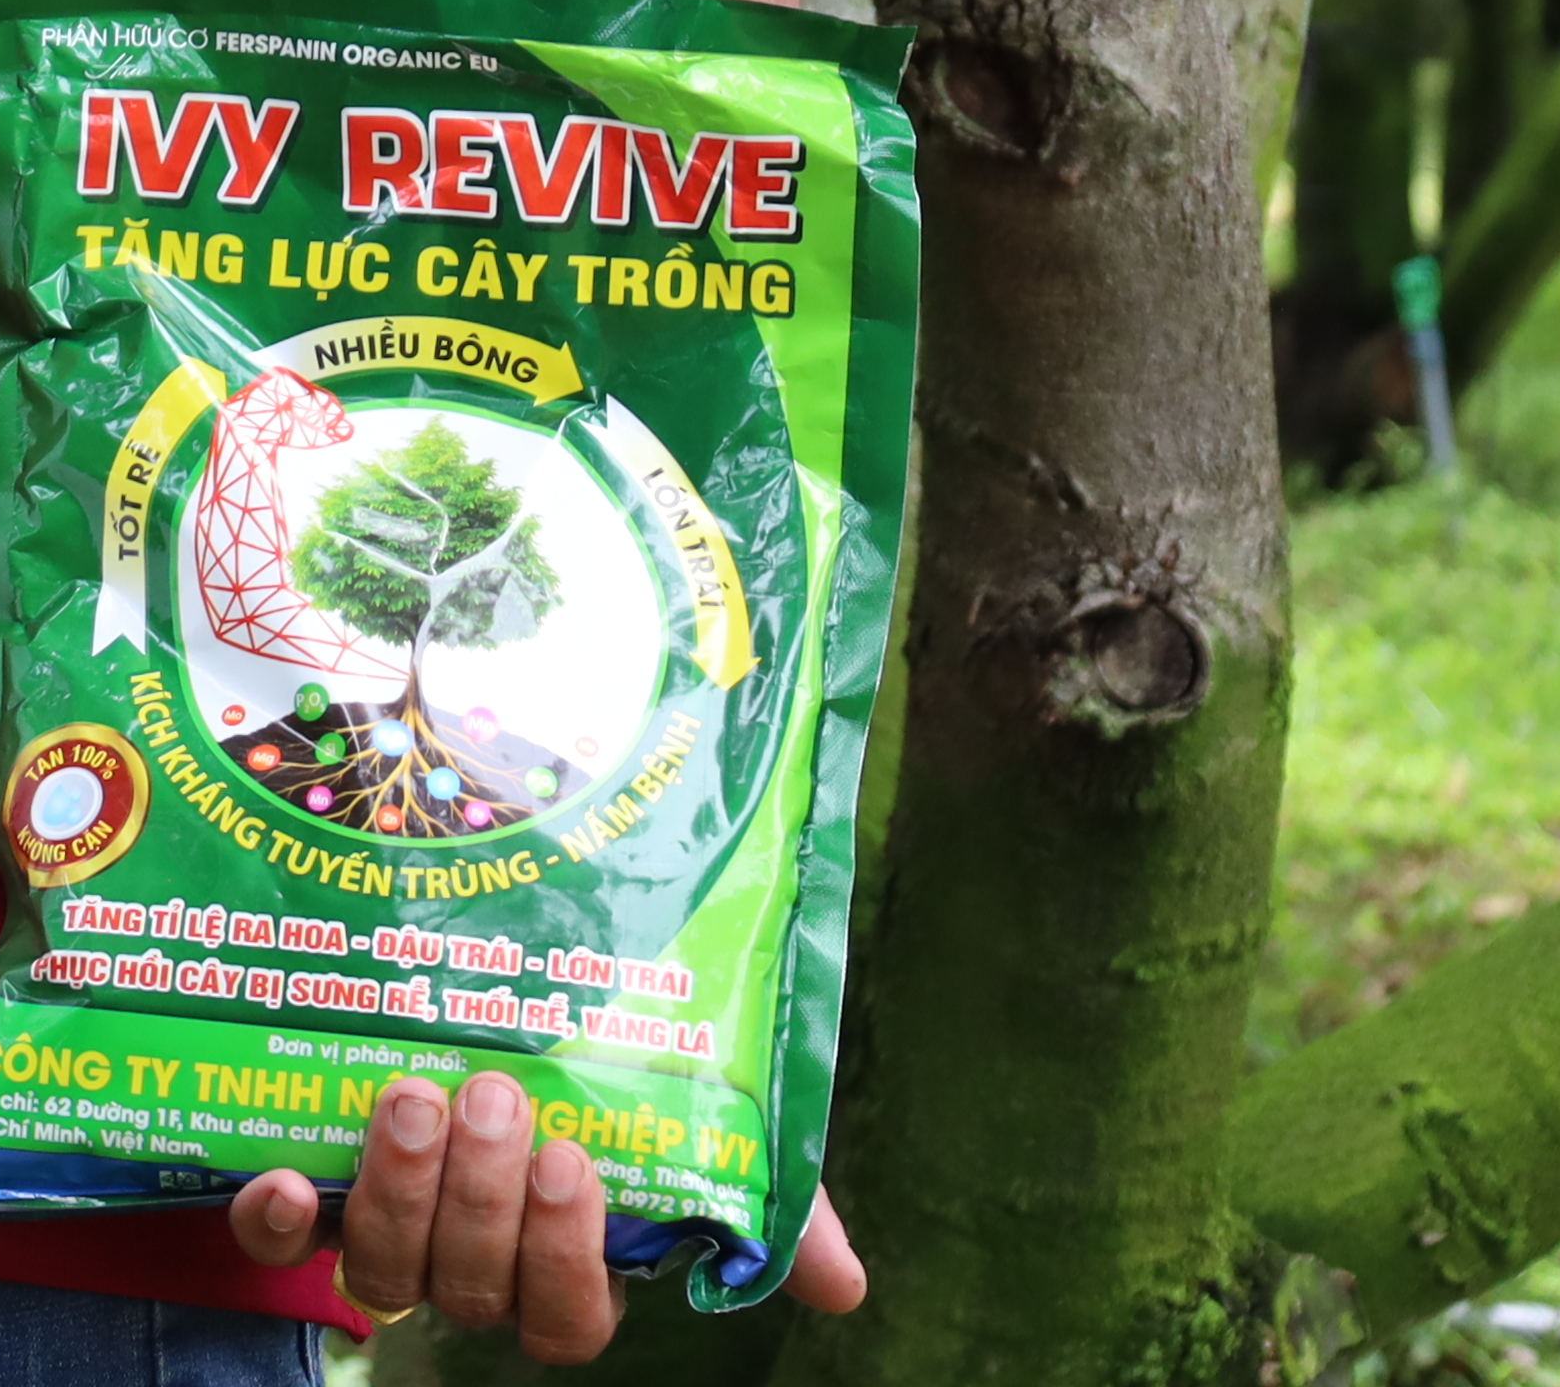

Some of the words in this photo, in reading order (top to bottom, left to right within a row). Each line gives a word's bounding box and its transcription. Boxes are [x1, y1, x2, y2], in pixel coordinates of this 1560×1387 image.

[41, 23, 107, 47] PHÂN
[114, 23, 162, 48] HỮU
[168, 27, 209, 50] CƠ
[215, 31, 337, 62] FERSPANIN
[342, 44, 462, 70] ORGANIC
[469, 52, 498, 72] EU
[76, 88, 301, 205] IVY
[341, 107, 801, 234] REVIVE
[76, 217, 245, 285] TĂNG
[269, 236, 391, 302] LỰC
[416, 238, 549, 303] CÂY
[568, 242, 792, 314] TRỒNG
[314, 319, 420, 370] NHIỀU
[433, 332, 539, 384] BÔNG
[111, 494, 144, 560] TỐT
[642, 467, 698, 532] LỚN
[682, 537, 730, 607] TRÁI
[24, 747, 65, 782] TAN
[71, 744, 120, 781] 100%
[130, 671, 179, 748] KÍCH
[157, 744, 267, 852] KHÁNG
[266, 829, 392, 897] TUYẾN
[400, 850, 541, 899] TRÙNG
[559, 793, 645, 864] NẤM
[631, 710, 702, 804] BỆNH
[16, 823, 66, 864] KHÔNG
[65, 898, 143, 932] TĂNG
[152, 900, 182, 936] TỈ
[185, 907, 224, 945] LỆ
[231, 915, 274, 945] RA
[281, 920, 345, 952] HOA
[375, 926, 442, 967] ĐẬU
[448, 937, 521, 973] TRÁI
[549, 948, 614, 985] LỚN
[621, 960, 690, 999] TRÁI
[33, 953, 109, 987] PHỤC
[116, 951, 170, 989] HỒI
[178, 959, 243, 997] CÂY
[247, 970, 282, 1008] BỊ
[289, 976, 378, 1011] SƯNG
[385, 980, 436, 1020] RỄ,
[445, 988, 518, 1027] THỐI
[524, 994, 575, 1037] RỄ,
[584, 1009, 667, 1048] VÀNG
[677, 1022, 712, 1058] LÁ
[268, 1034, 313, 1057] Đơn
[319, 1041, 339, 1065] vị
[345, 1044, 404, 1069] phân
[410, 1049, 468, 1072] phối:
[0, 1089, 39, 1114] chỉ:
[43, 1098, 70, 1117] 62
[77, 1099, 150, 1129] Đường
[155, 1107, 183, 1132] 1F,
[189, 1111, 233, 1135] Khu
[239, 1116, 281, 1139] dân
[289, 1124, 319, 1143] cư
[126, 1055, 180, 1097] TY
[194, 1062, 323, 1113] TNHH
[697, 1125, 757, 1176] IVY
[33, 1122, 94, 1147] Minh,
[100, 1127, 145, 1156] Việt
[150, 1135, 210, 1158] Nam.
[619, 1189, 676, 1214] 0972
